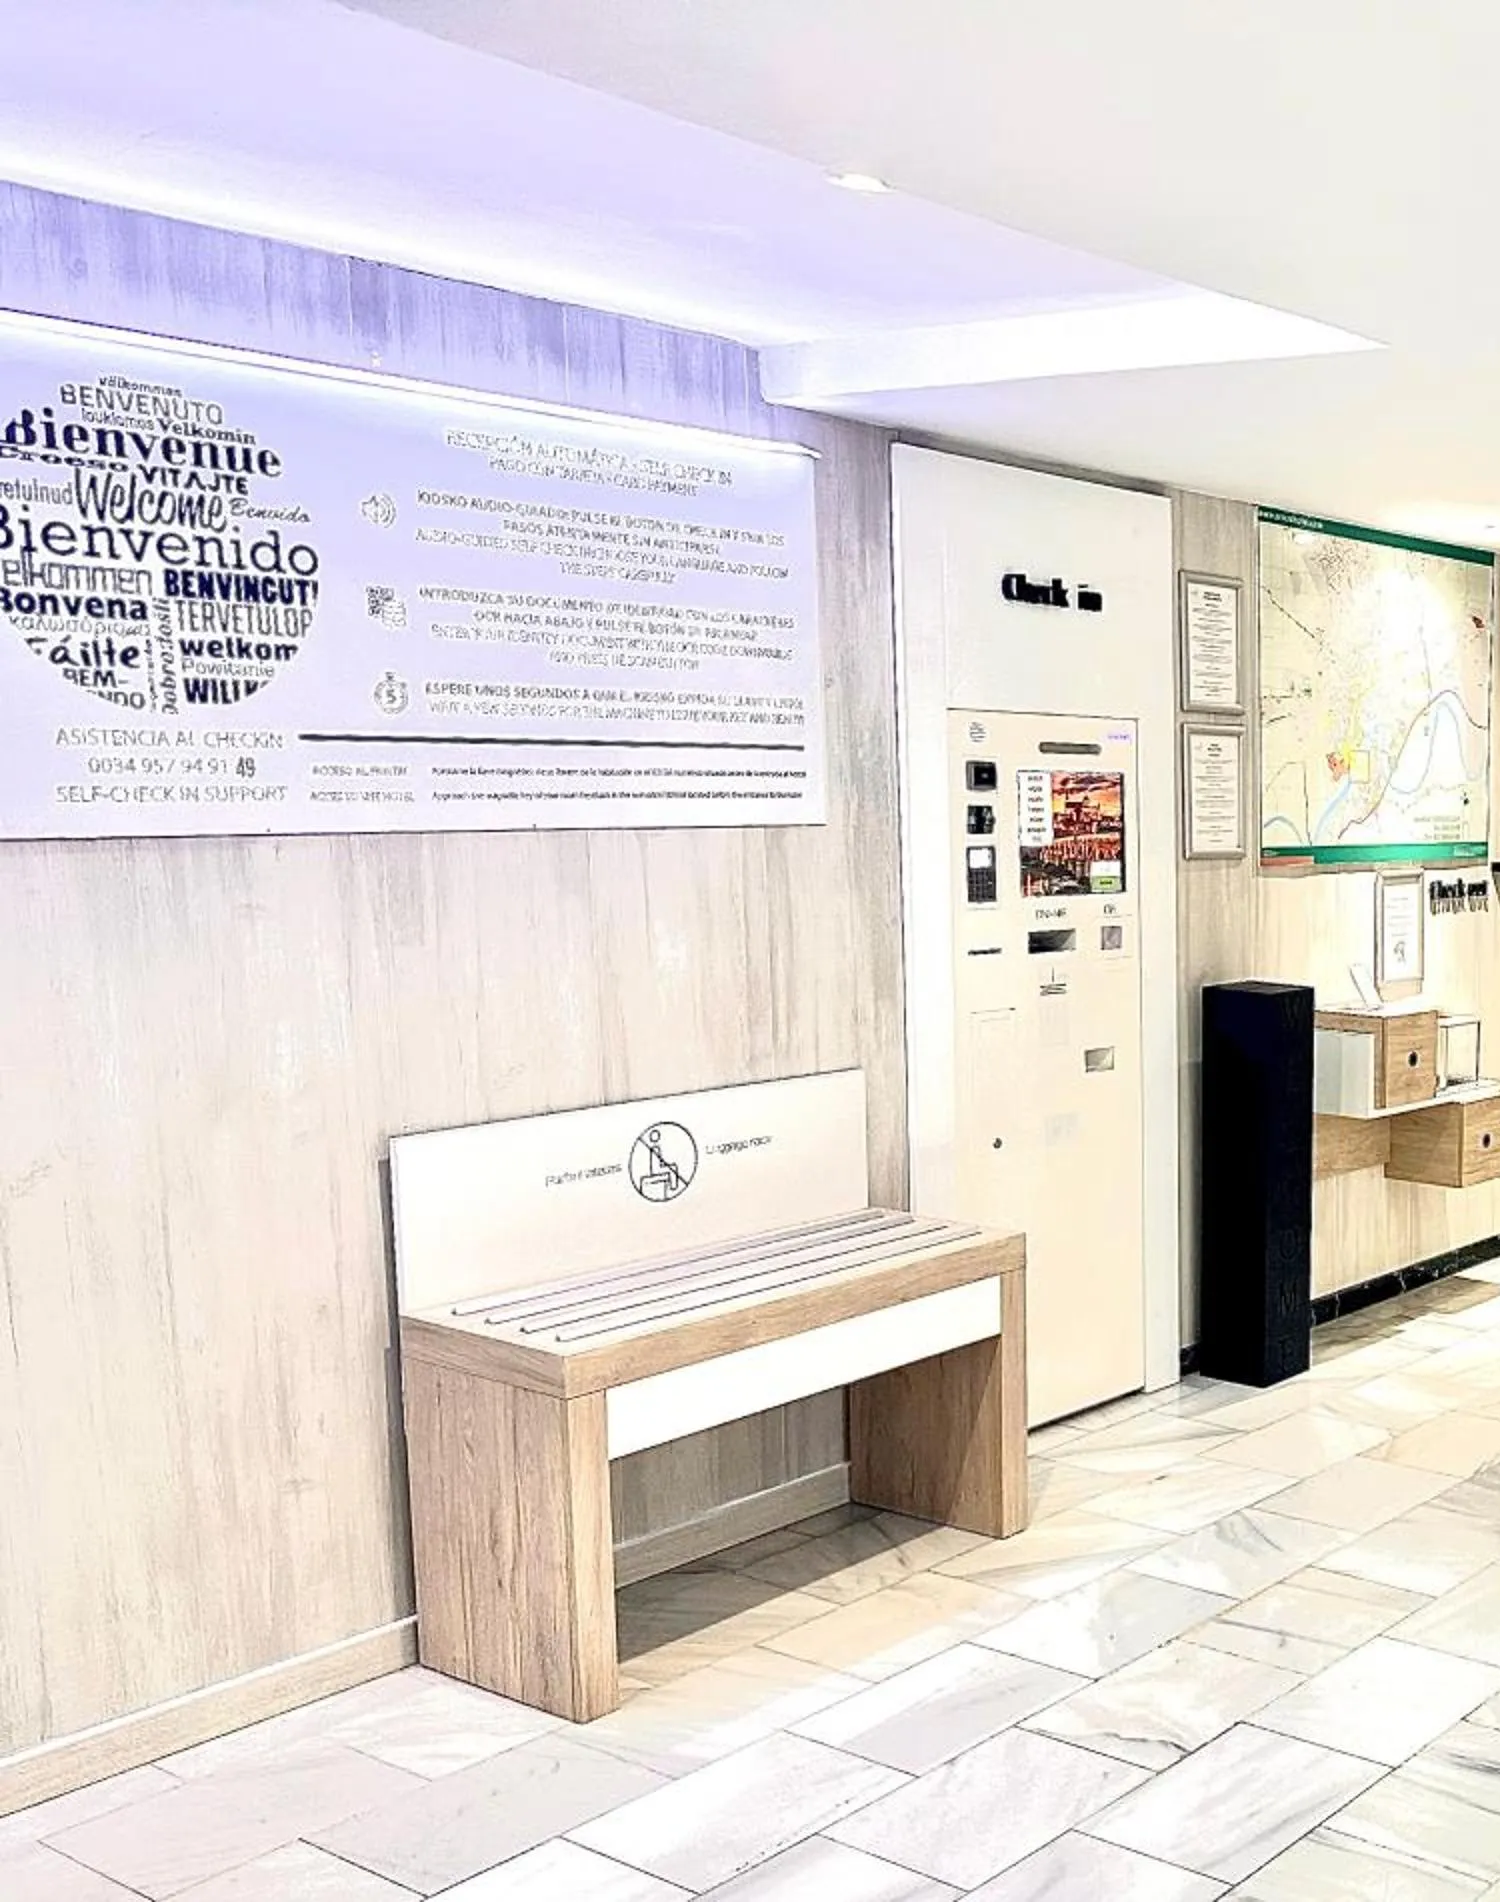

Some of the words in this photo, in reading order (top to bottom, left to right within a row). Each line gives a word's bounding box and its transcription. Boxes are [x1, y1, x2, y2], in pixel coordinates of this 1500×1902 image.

[61, 384, 223, 425] BENVENUTO
[156, 416, 256, 445] Velkomin
[137, 464, 249, 496] VITAJTE
[75, 467, 228, 533] Welcome
[0, 503, 319, 576] Bienvenido
[0, 588, 148, 621] Bonvena
[1001, 573, 1070, 608] Check
[55, 728, 170, 748] ASISTENCIA
[88, 757, 137, 774] 0034
[180, 758, 204, 774] 94
[235, 756, 256, 778] 49
